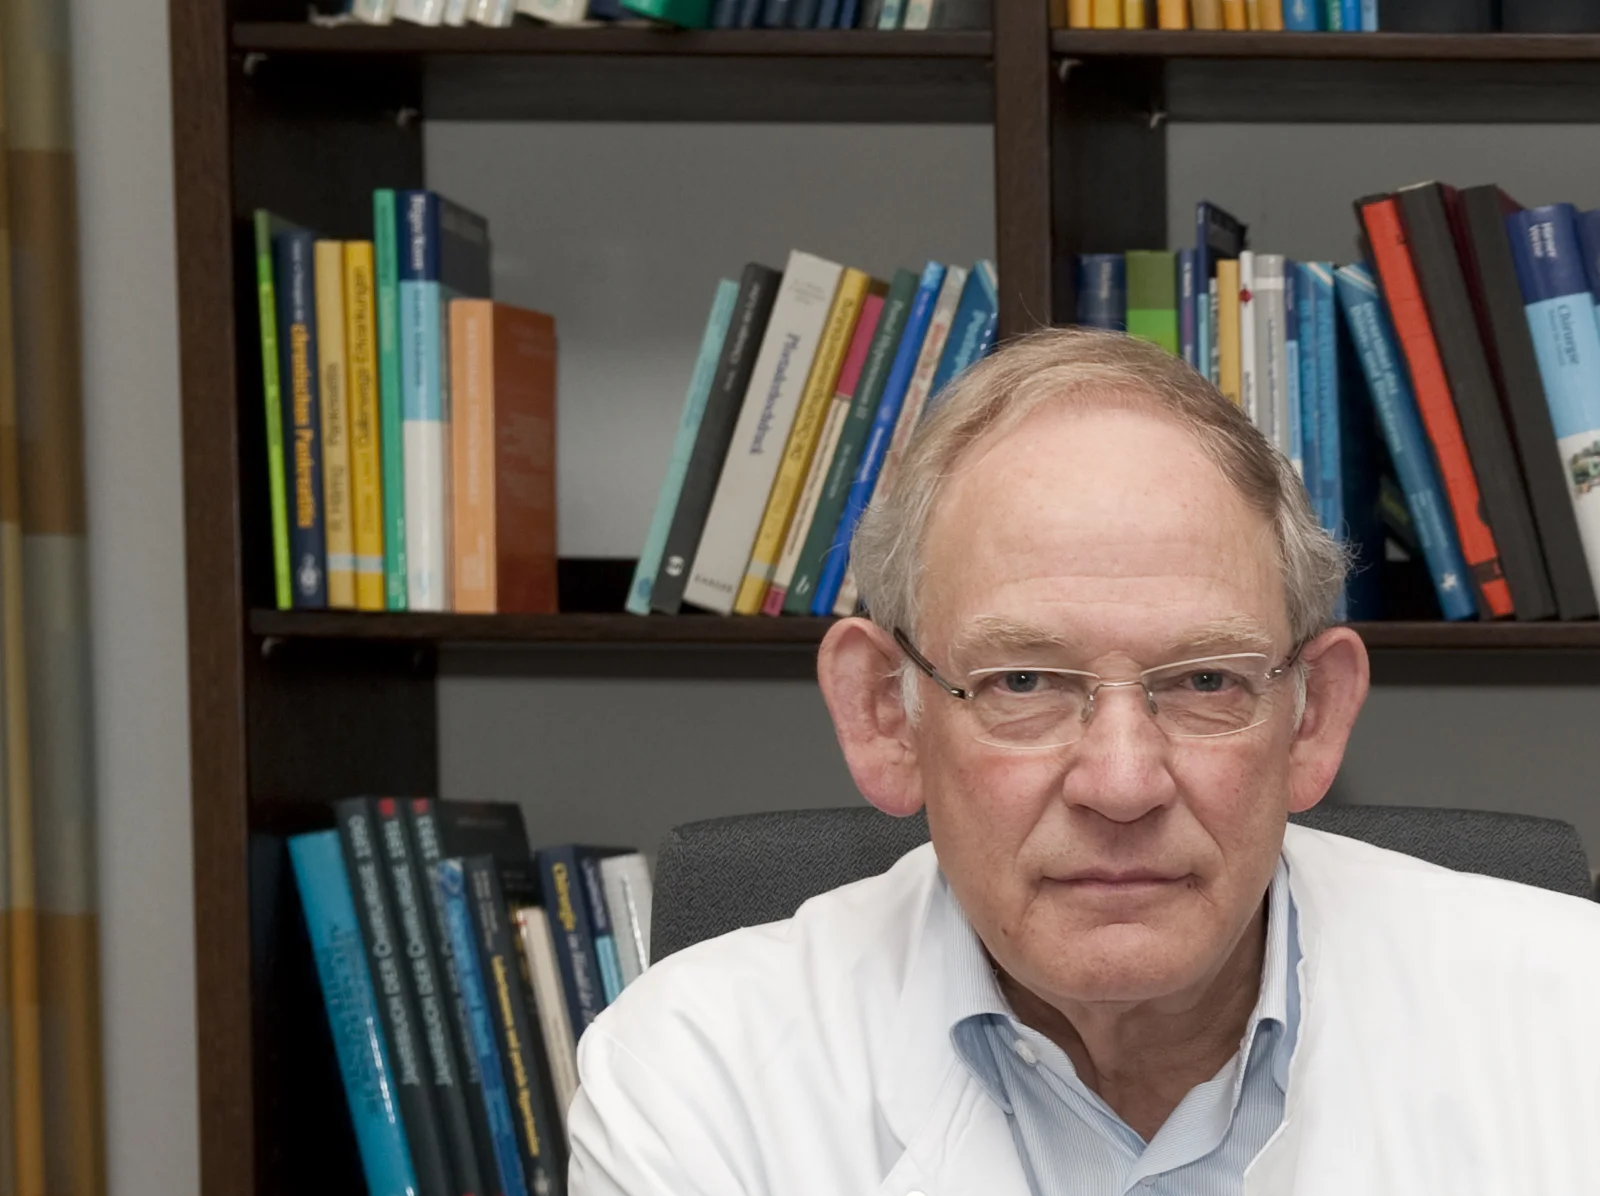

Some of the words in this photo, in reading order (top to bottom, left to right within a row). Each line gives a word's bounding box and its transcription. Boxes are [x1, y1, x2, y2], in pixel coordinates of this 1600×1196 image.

[295, 428, 316, 528] Pankreatitis
[358, 861, 393, 958] CHIRURGIE
[552, 862, 576, 932] Chirurgie
